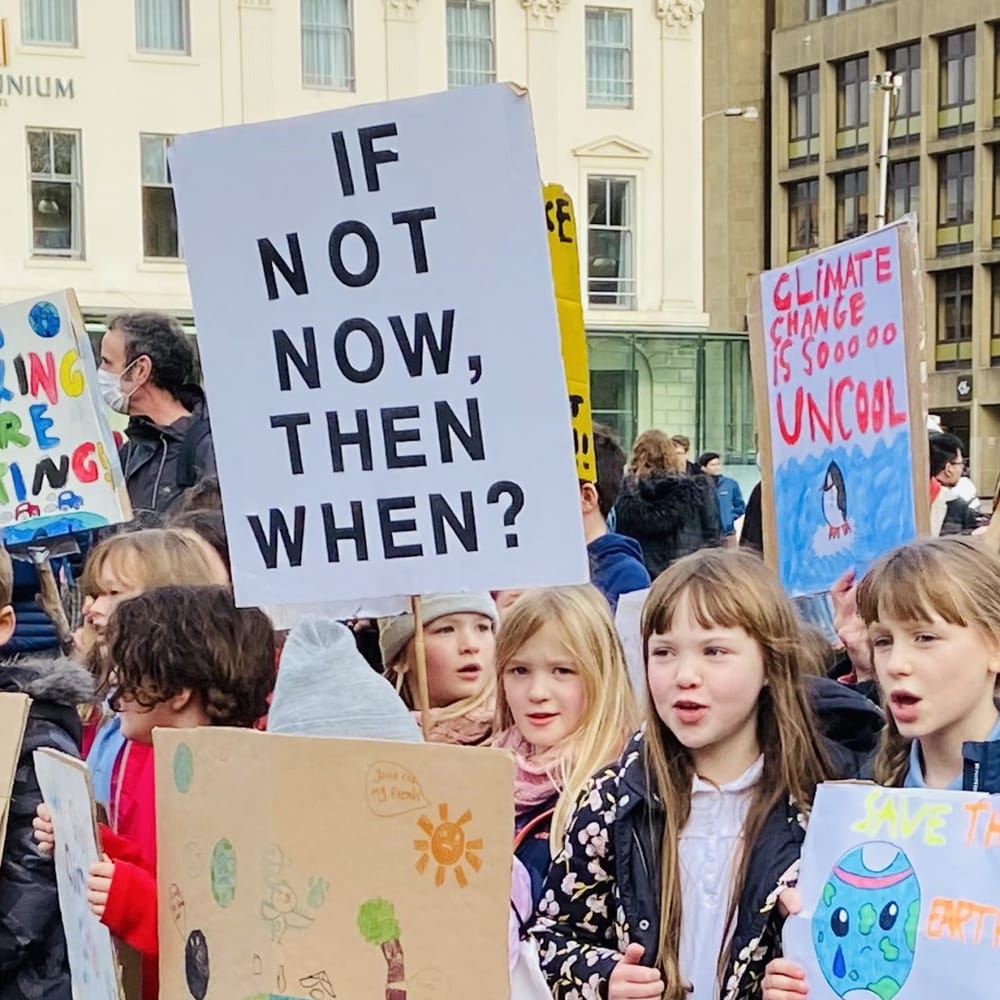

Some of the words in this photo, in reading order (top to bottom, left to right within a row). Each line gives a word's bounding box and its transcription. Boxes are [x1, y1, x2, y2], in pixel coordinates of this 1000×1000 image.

[332, 123, 399, 196] IF
[257, 206, 436, 300] NOT
[272, 309, 482, 391] NOW,
[770, 292, 865, 346] CHANGE
[269, 397, 486, 475] THEN
[776, 376, 907, 446] UNCOOL
[247, 480, 525, 569] WHEN?
[851, 789, 952, 846] SAVE
